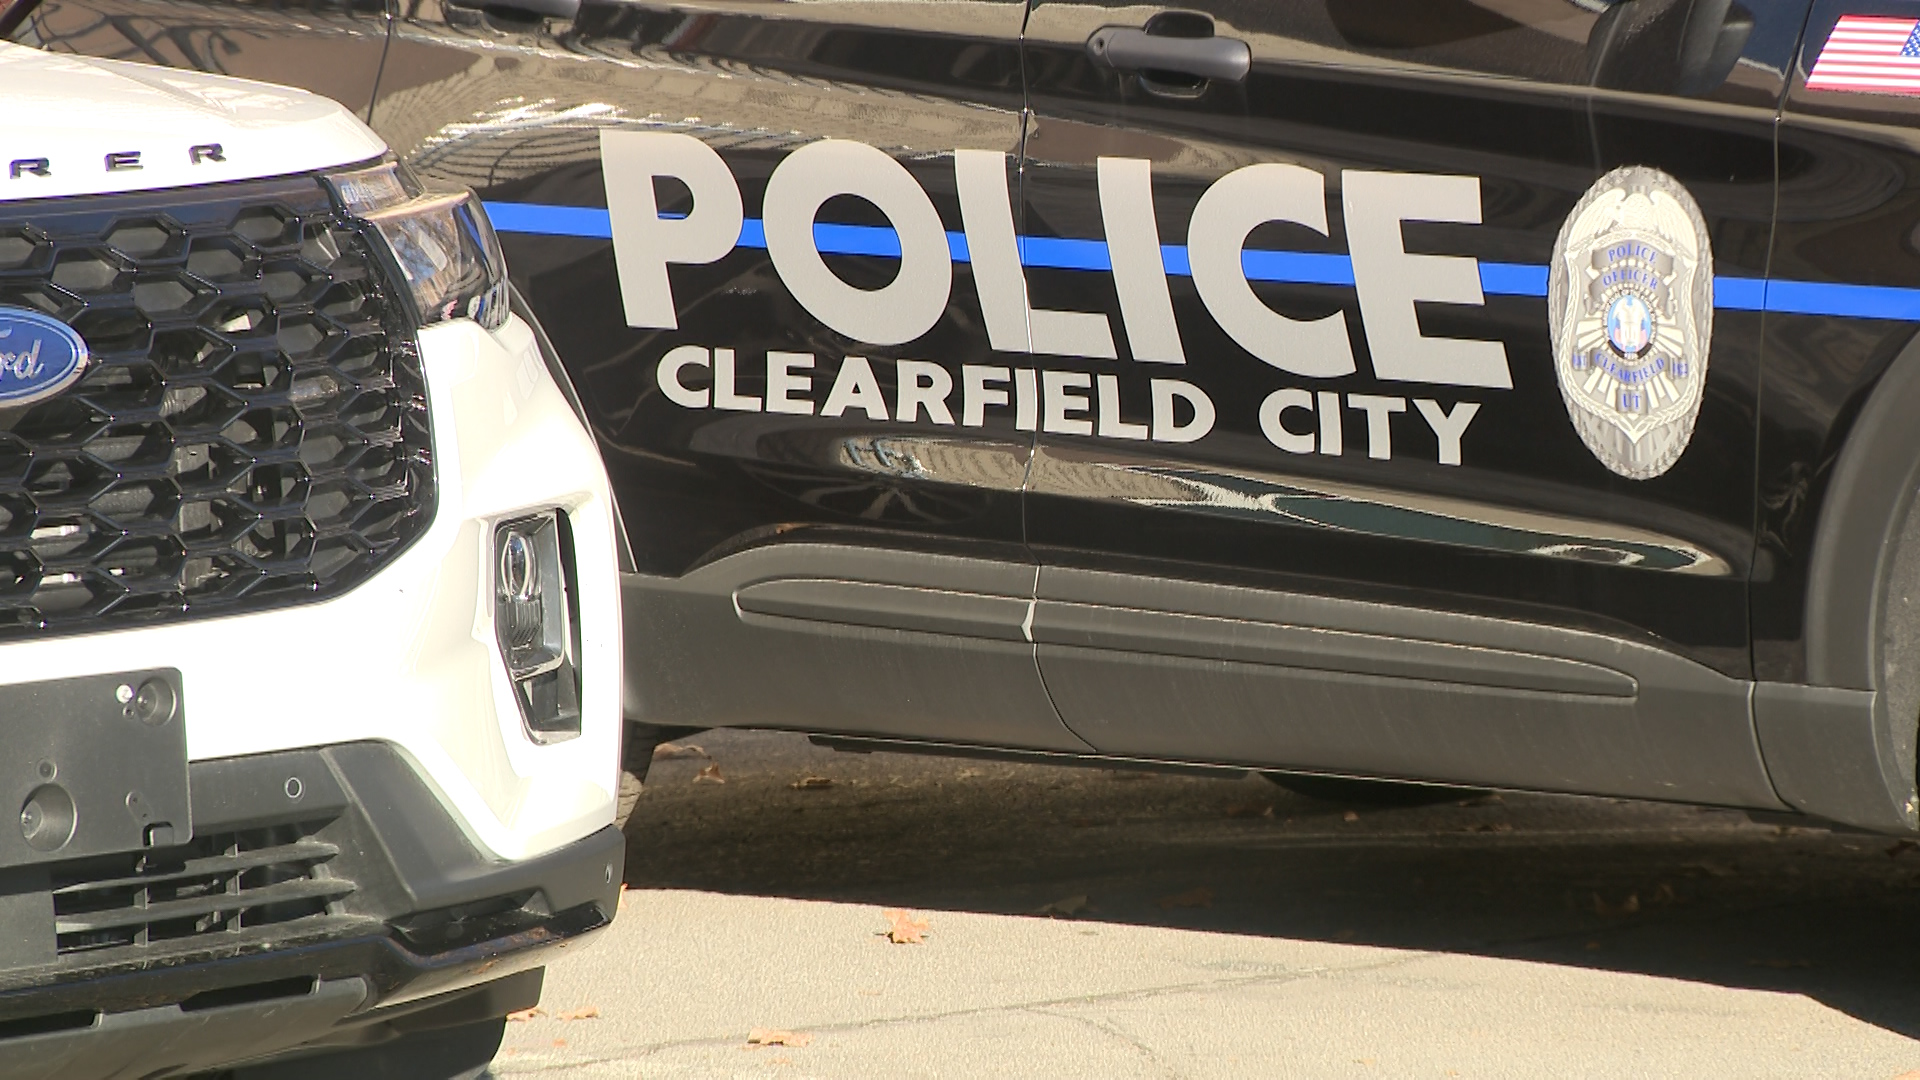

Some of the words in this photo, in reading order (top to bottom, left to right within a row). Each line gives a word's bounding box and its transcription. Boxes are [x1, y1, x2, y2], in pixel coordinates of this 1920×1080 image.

[600, 130, 1514, 389] POLICE
[1608, 243, 1657, 263] POLICE
[1602, 269, 1658, 290] OFFICER
[1594, 352, 1666, 383] CLEARFIELD
[657, 345, 1216, 443] CLEARFIELD
[1258, 387, 1482, 466] CITY
[1623, 393, 1641, 409] UT
